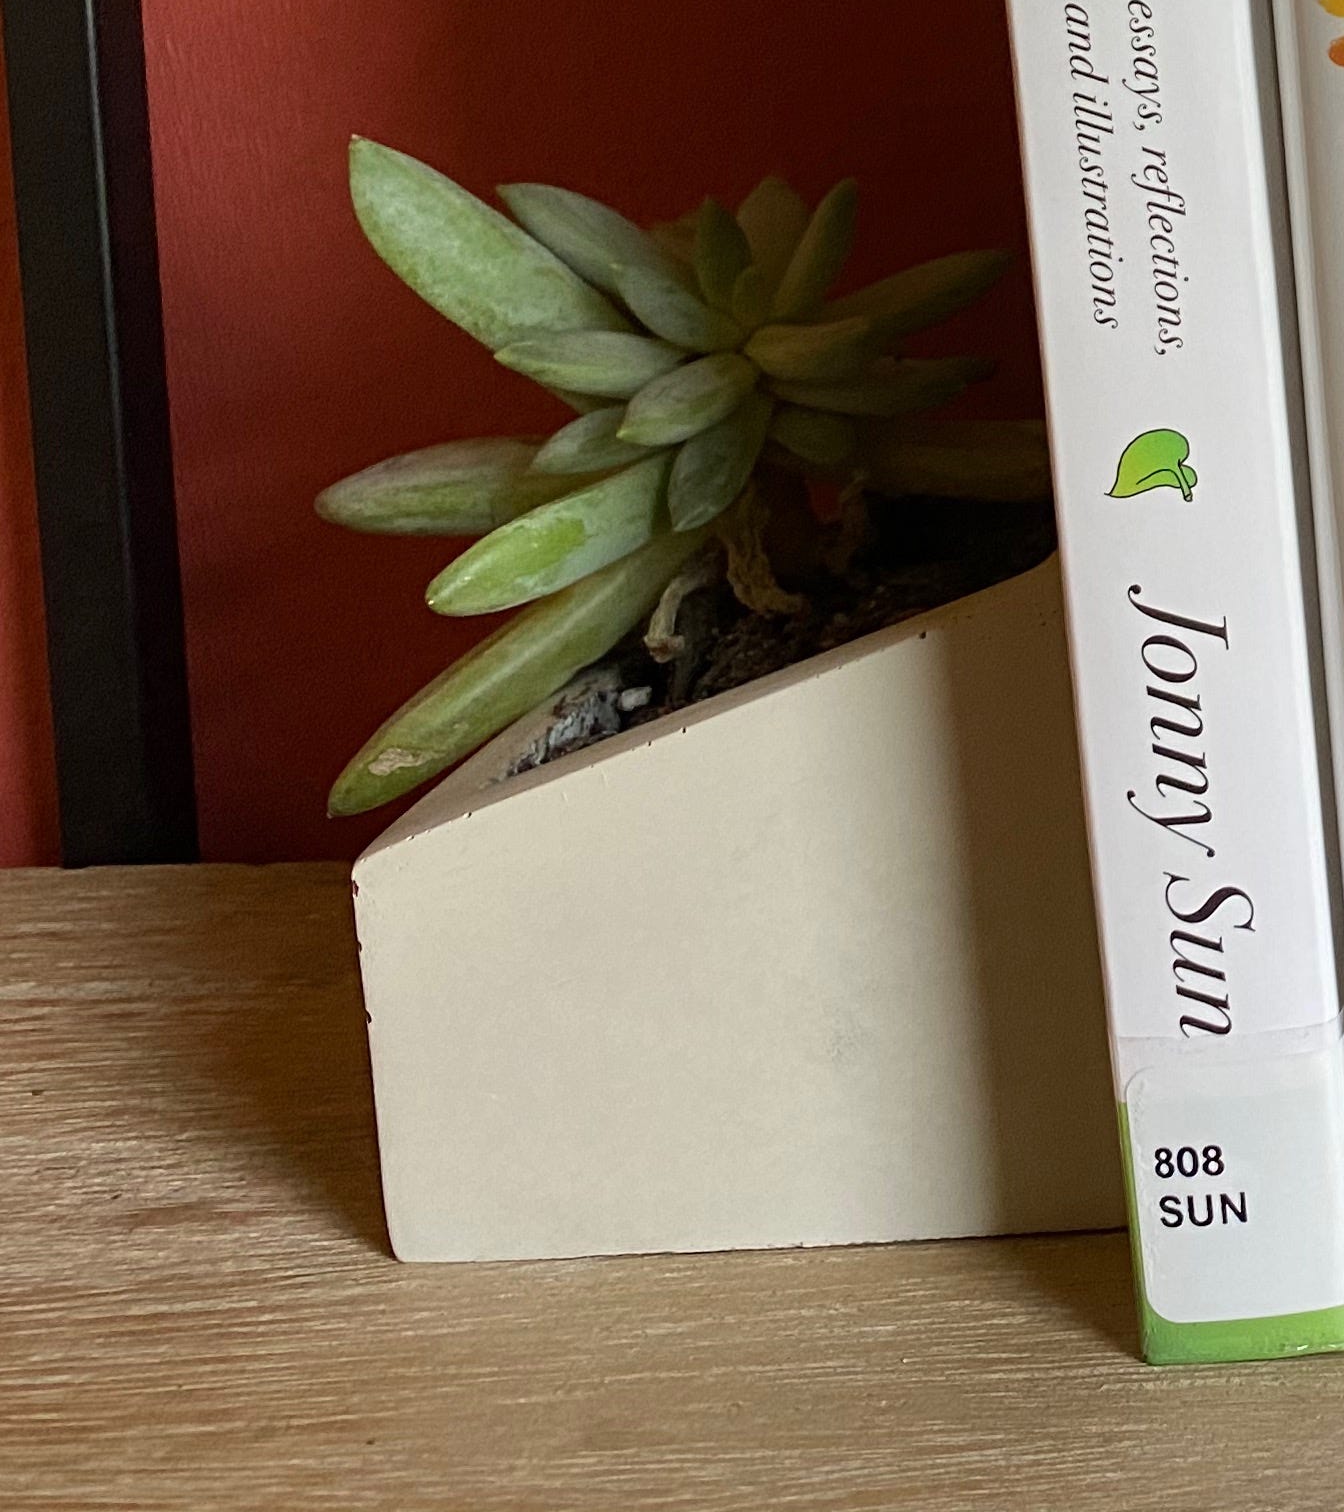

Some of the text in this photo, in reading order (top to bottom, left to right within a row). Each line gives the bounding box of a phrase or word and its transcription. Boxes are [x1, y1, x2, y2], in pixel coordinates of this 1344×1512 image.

[1063, 1, 1125, 328] and illustrations
[1141, 147, 1187, 357] reflections,
[1128, 583, 1256, 1039] Jonny Sun
[1153, 1144, 1225, 1179] 808
[1158, 1192, 1248, 1227] SUN
